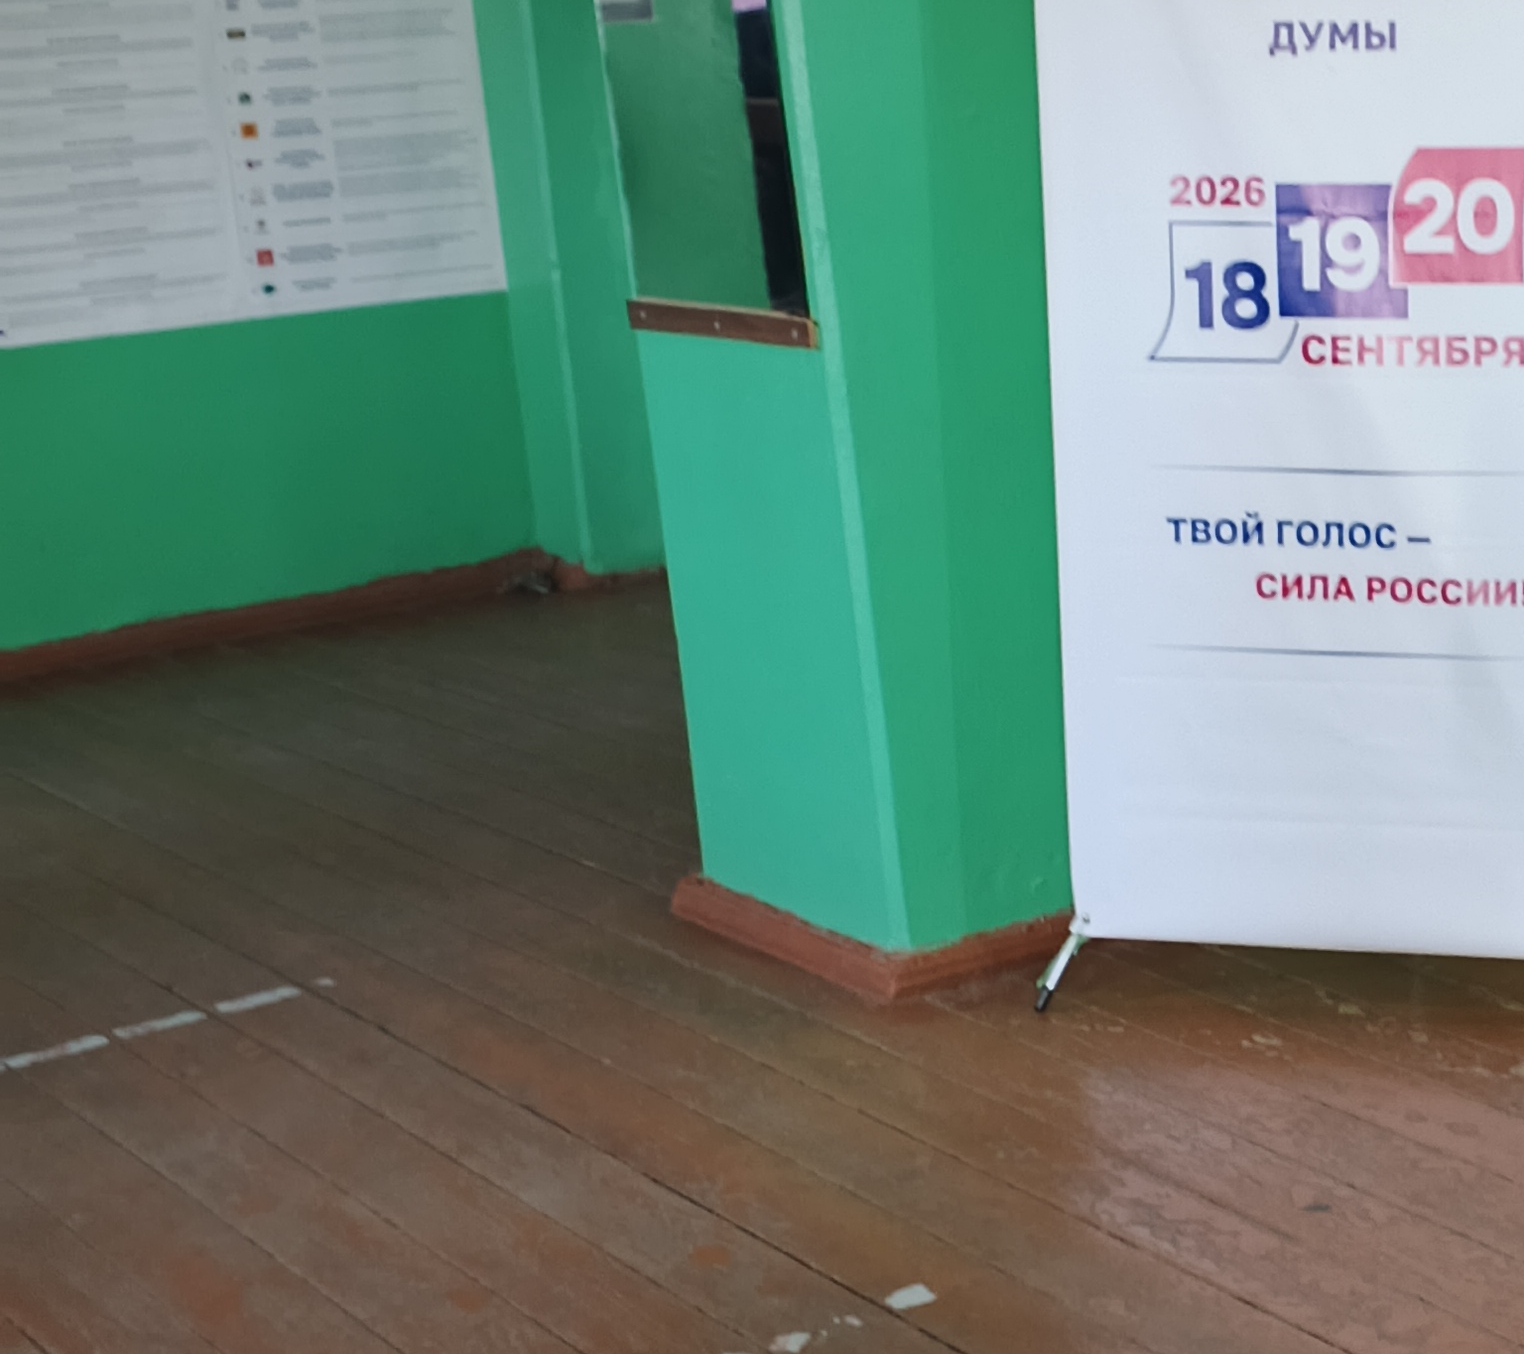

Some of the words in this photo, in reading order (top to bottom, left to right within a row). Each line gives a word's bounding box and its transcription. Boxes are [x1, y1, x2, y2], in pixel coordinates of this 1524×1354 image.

[1269, 20, 1397, 57] ДУМЫ
[1169, 175, 1266, 206] 2026
[1184, 260, 1271, 330] 18
[1288, 216, 1381, 292] 19
[1403, 177, 1515, 255] 20
[1166, 511, 1264, 544] ТВОЙ
[1276, 519, 1397, 549] ГОЛОС
[1255, 572, 1356, 602] СИЛА
